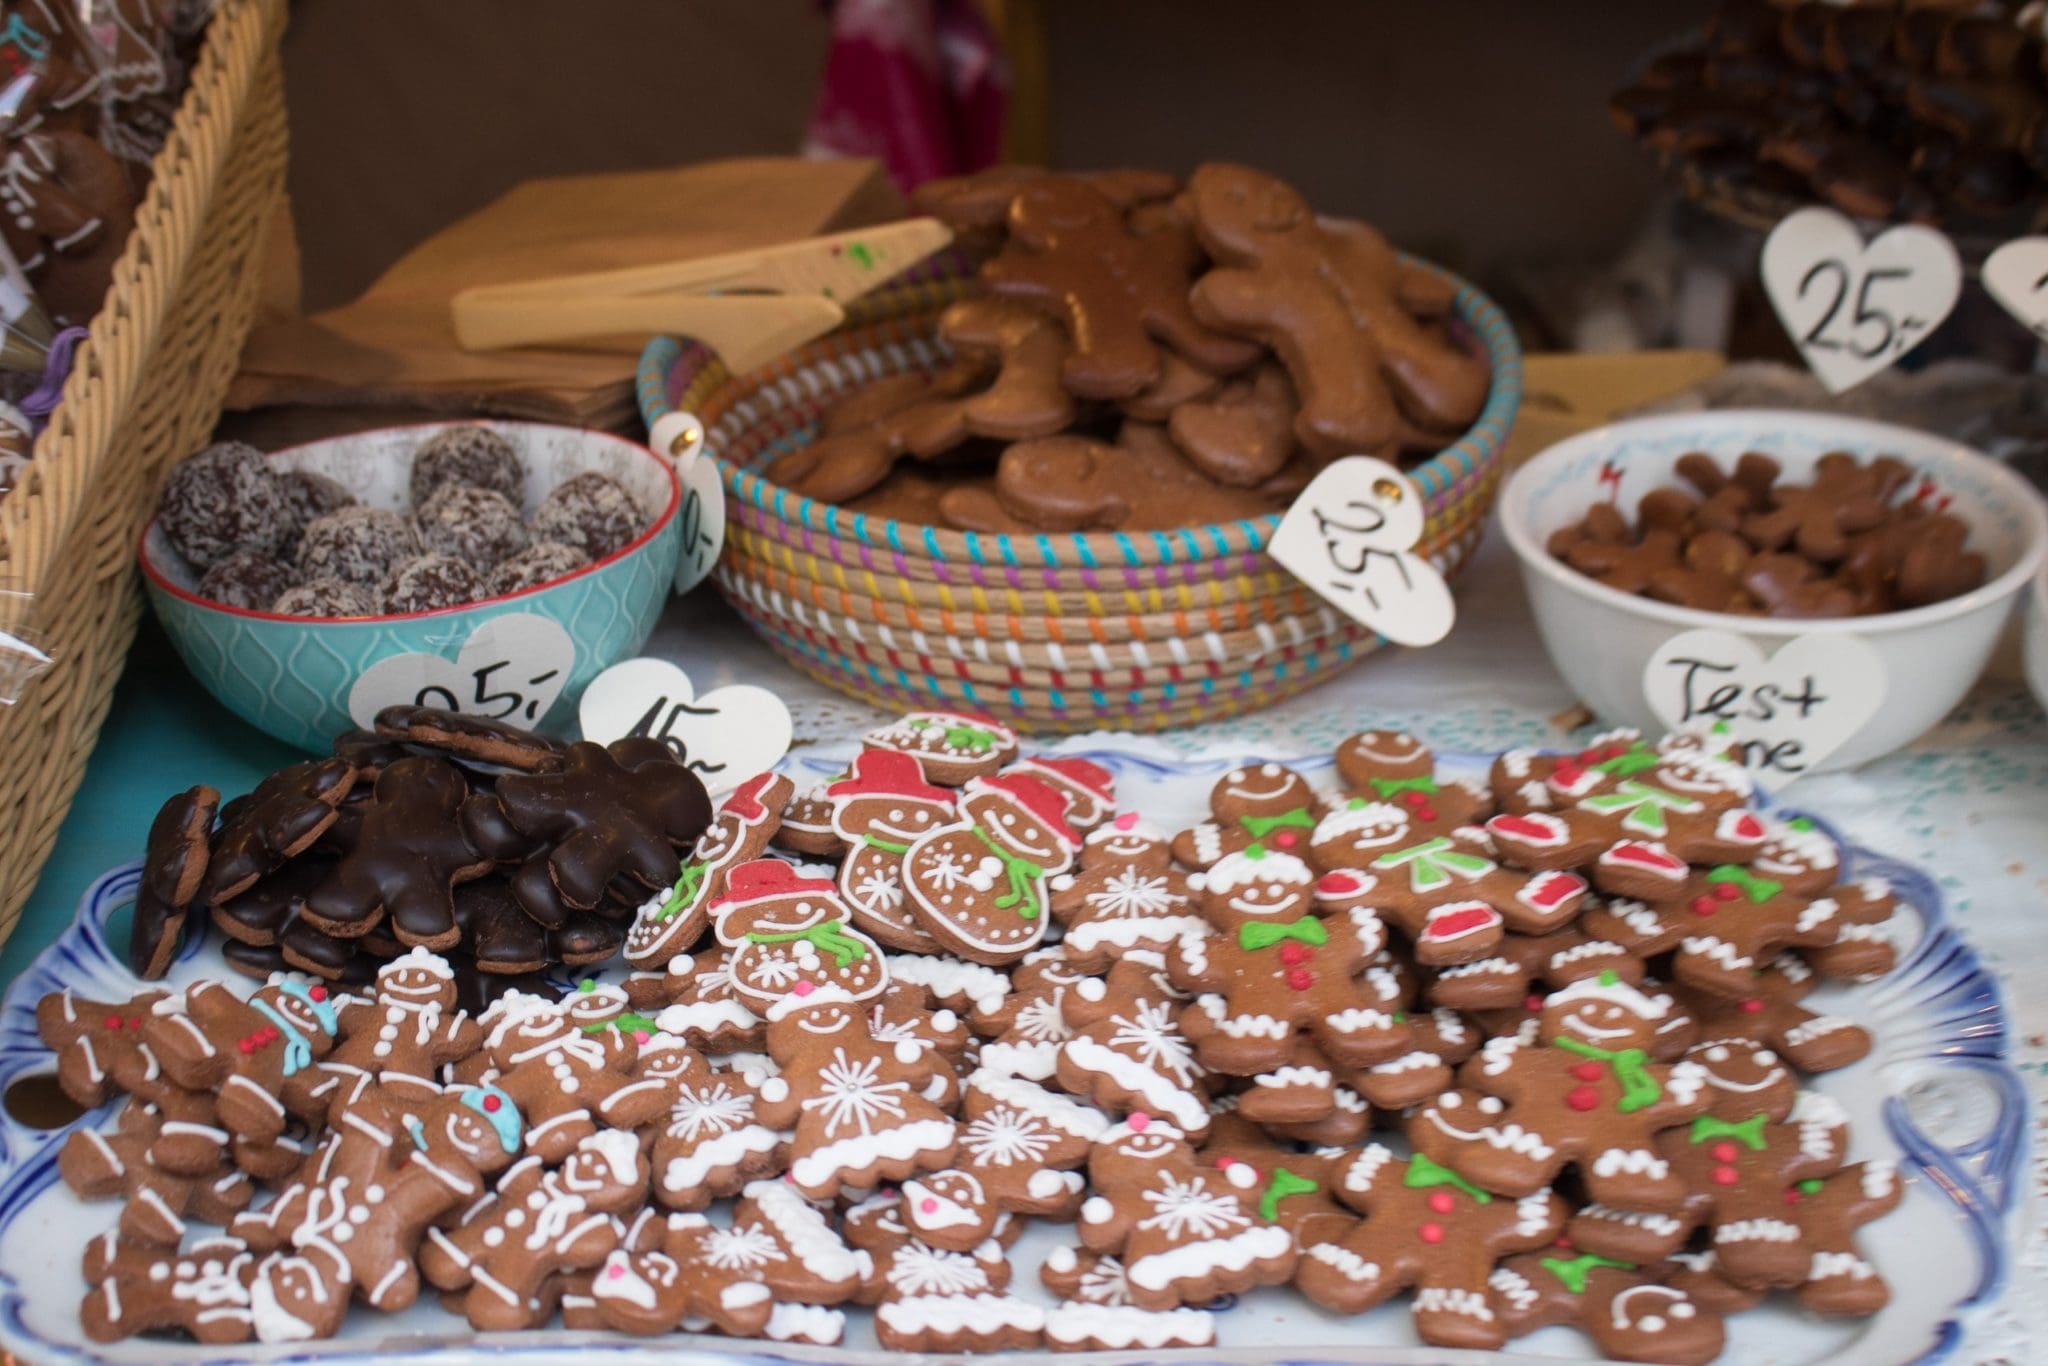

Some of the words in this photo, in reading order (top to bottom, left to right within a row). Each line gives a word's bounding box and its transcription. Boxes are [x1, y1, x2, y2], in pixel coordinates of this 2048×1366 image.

[1798, 259, 1926, 359] 25,-
[683, 488, 713, 573] 0,-
[1311, 502, 1414, 611] 25,-
[1666, 657, 1828, 723] Test
